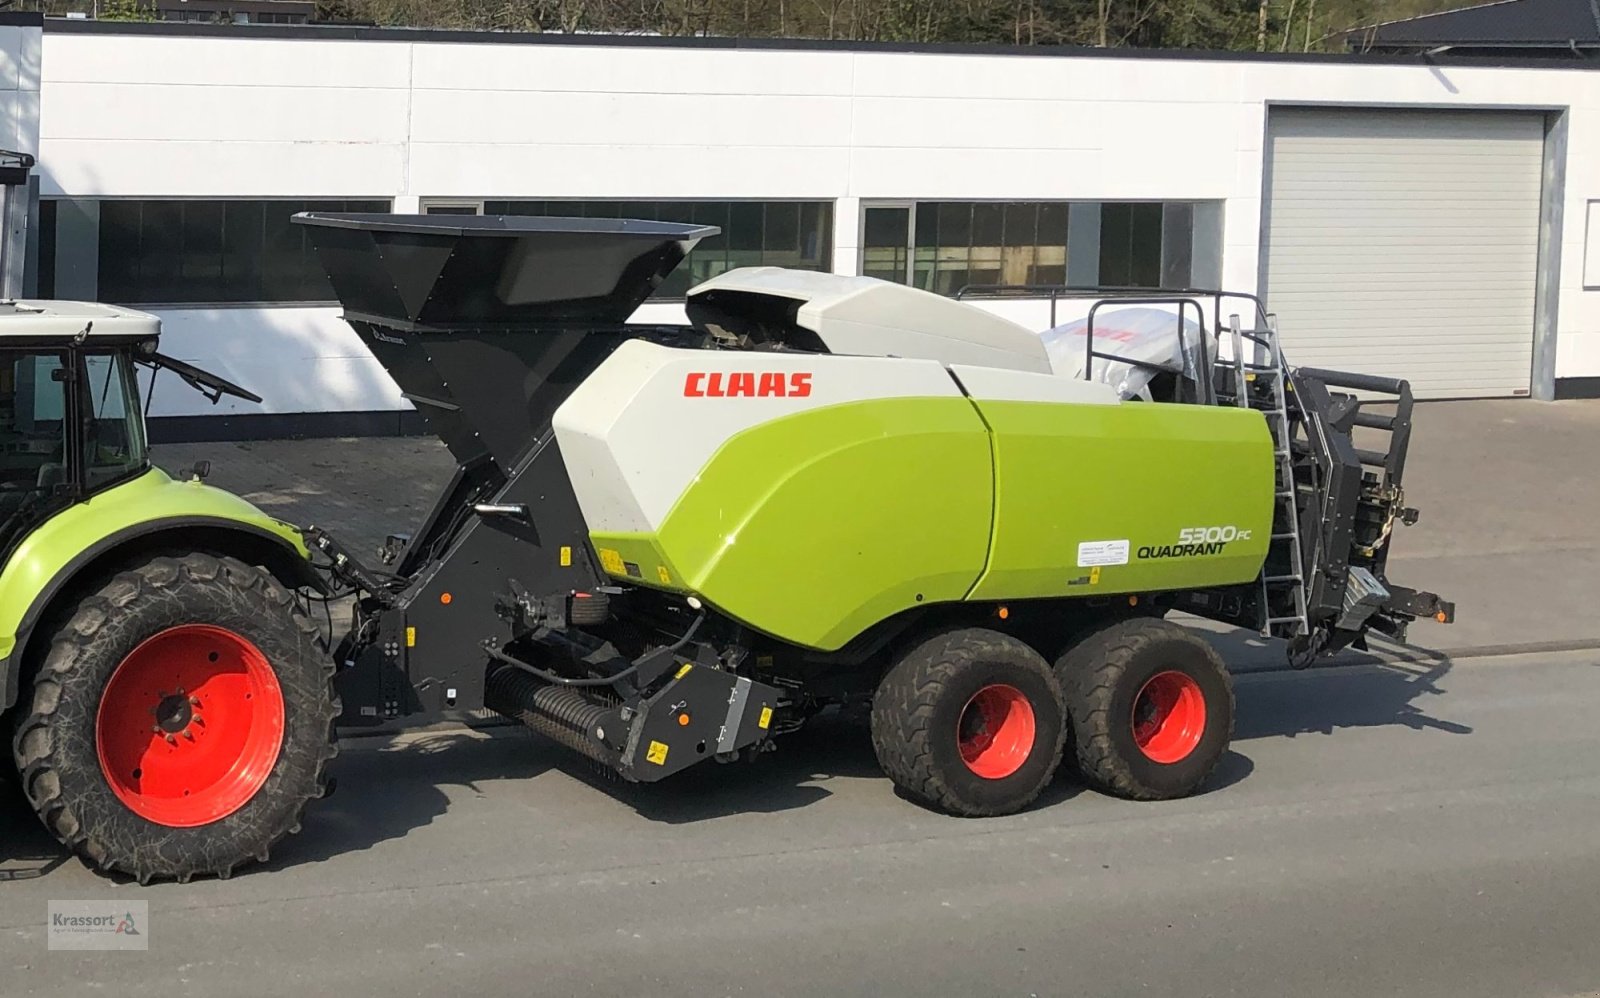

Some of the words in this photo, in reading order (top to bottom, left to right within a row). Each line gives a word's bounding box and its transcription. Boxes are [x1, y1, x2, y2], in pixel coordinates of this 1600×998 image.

[683, 372, 812, 397] CLAAS
[1177, 525, 1237, 545] 5300
[1137, 542, 1227, 559] QUADRANT
